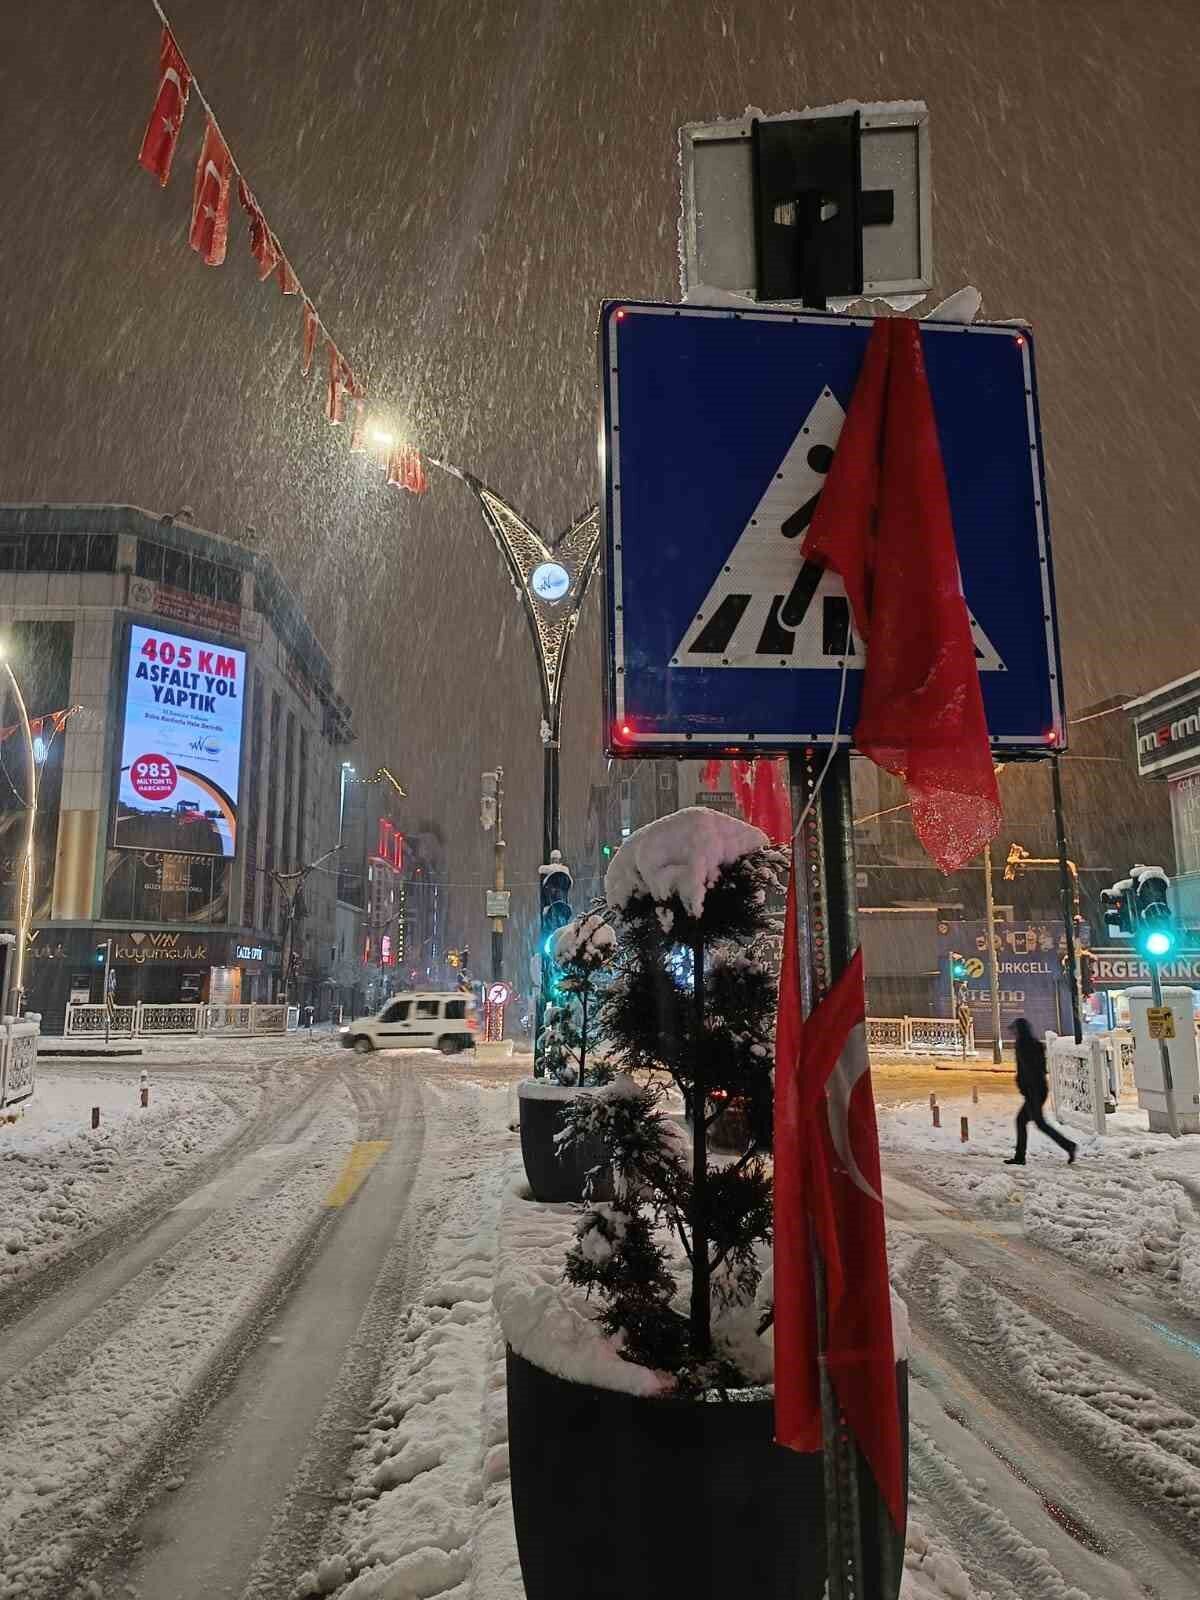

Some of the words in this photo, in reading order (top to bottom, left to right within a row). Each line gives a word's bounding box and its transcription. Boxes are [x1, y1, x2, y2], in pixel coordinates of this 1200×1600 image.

[141, 638, 192, 669] 405
[198, 650, 237, 680] KM
[136, 662, 200, 691] ASFALT
[205, 676, 237, 698] YOL
[152, 685, 217, 713] YAPTIK
[137, 762, 170, 778] 985
[997, 962, 1053, 974] URKCELL
